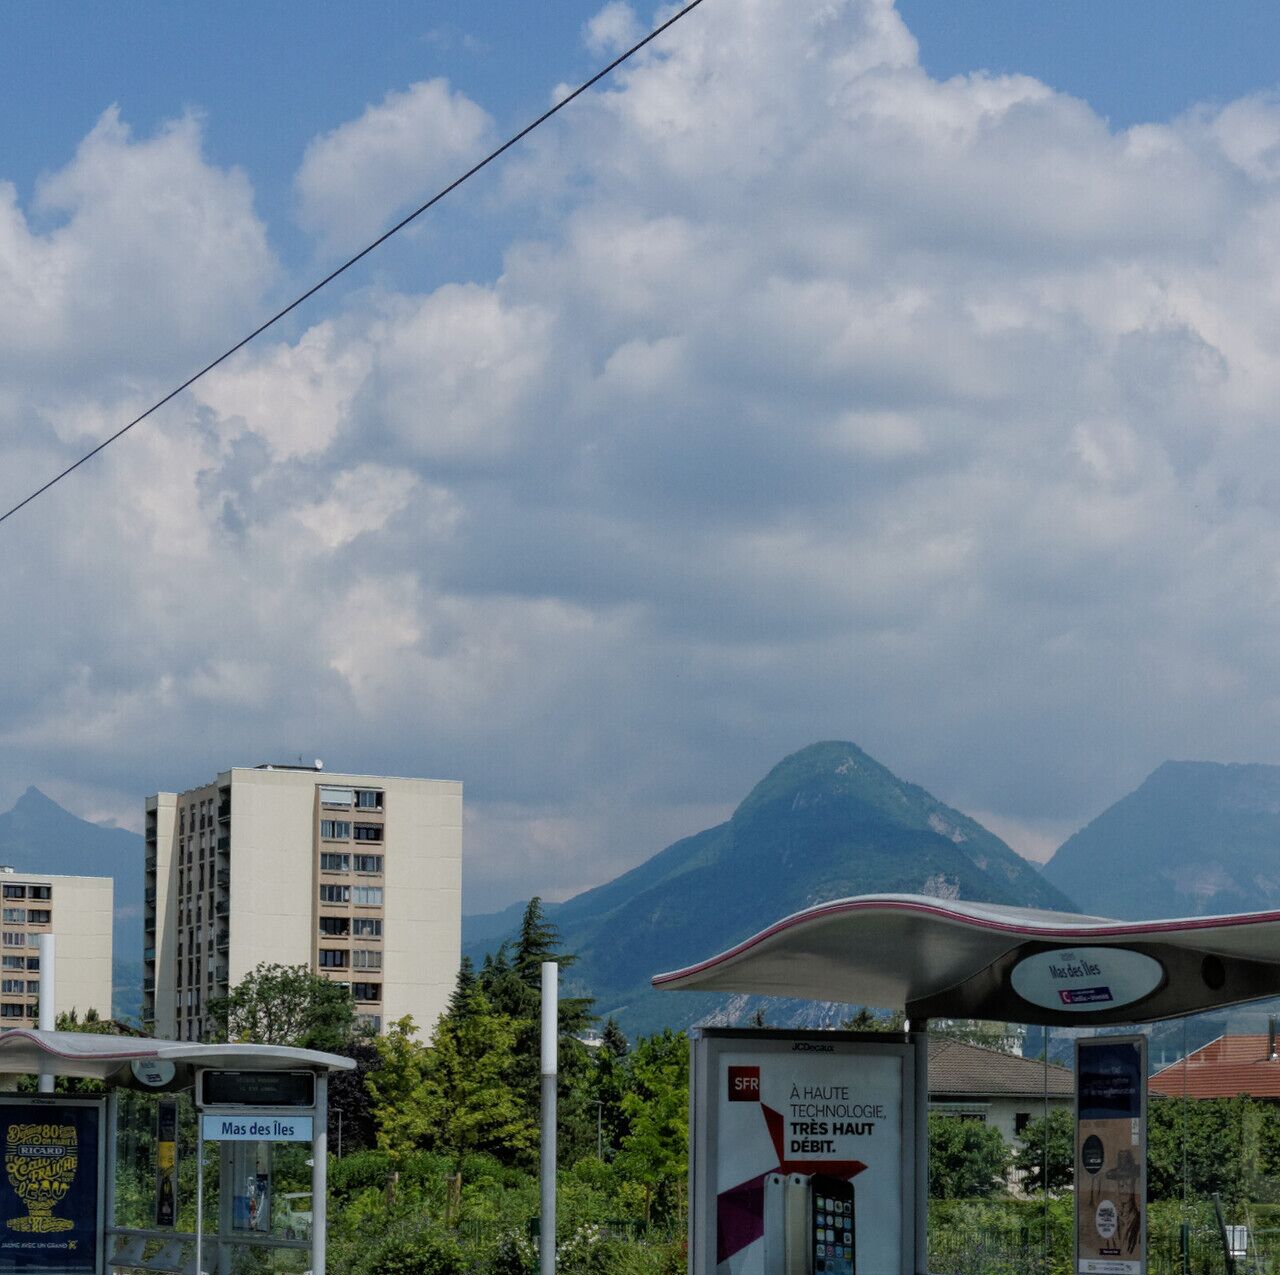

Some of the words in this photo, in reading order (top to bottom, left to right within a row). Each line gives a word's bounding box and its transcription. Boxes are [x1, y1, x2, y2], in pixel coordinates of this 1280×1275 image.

[1048, 965, 1067, 979] Mas
[1067, 963, 1084, 978] des
[792, 1042, 835, 1051] JCDecaux
[734, 1077, 759, 1090] SFR
[790, 1083, 800, 1100] À
[804, 1086, 849, 1100] HAUTE
[790, 1104, 887, 1120] TECHNOLOGIE,
[42, 1124, 59, 1138] 80
[221, 1122, 246, 1135] Mas
[249, 1122, 271, 1136] des
[273, 1120, 295, 1136] Îles
[790, 1119, 828, 1135] TRÈS
[832, 1122, 875, 1135] HAUT
[20, 1146, 63, 1155] RICARD
[790, 1137, 837, 1153] DÉBIT.
